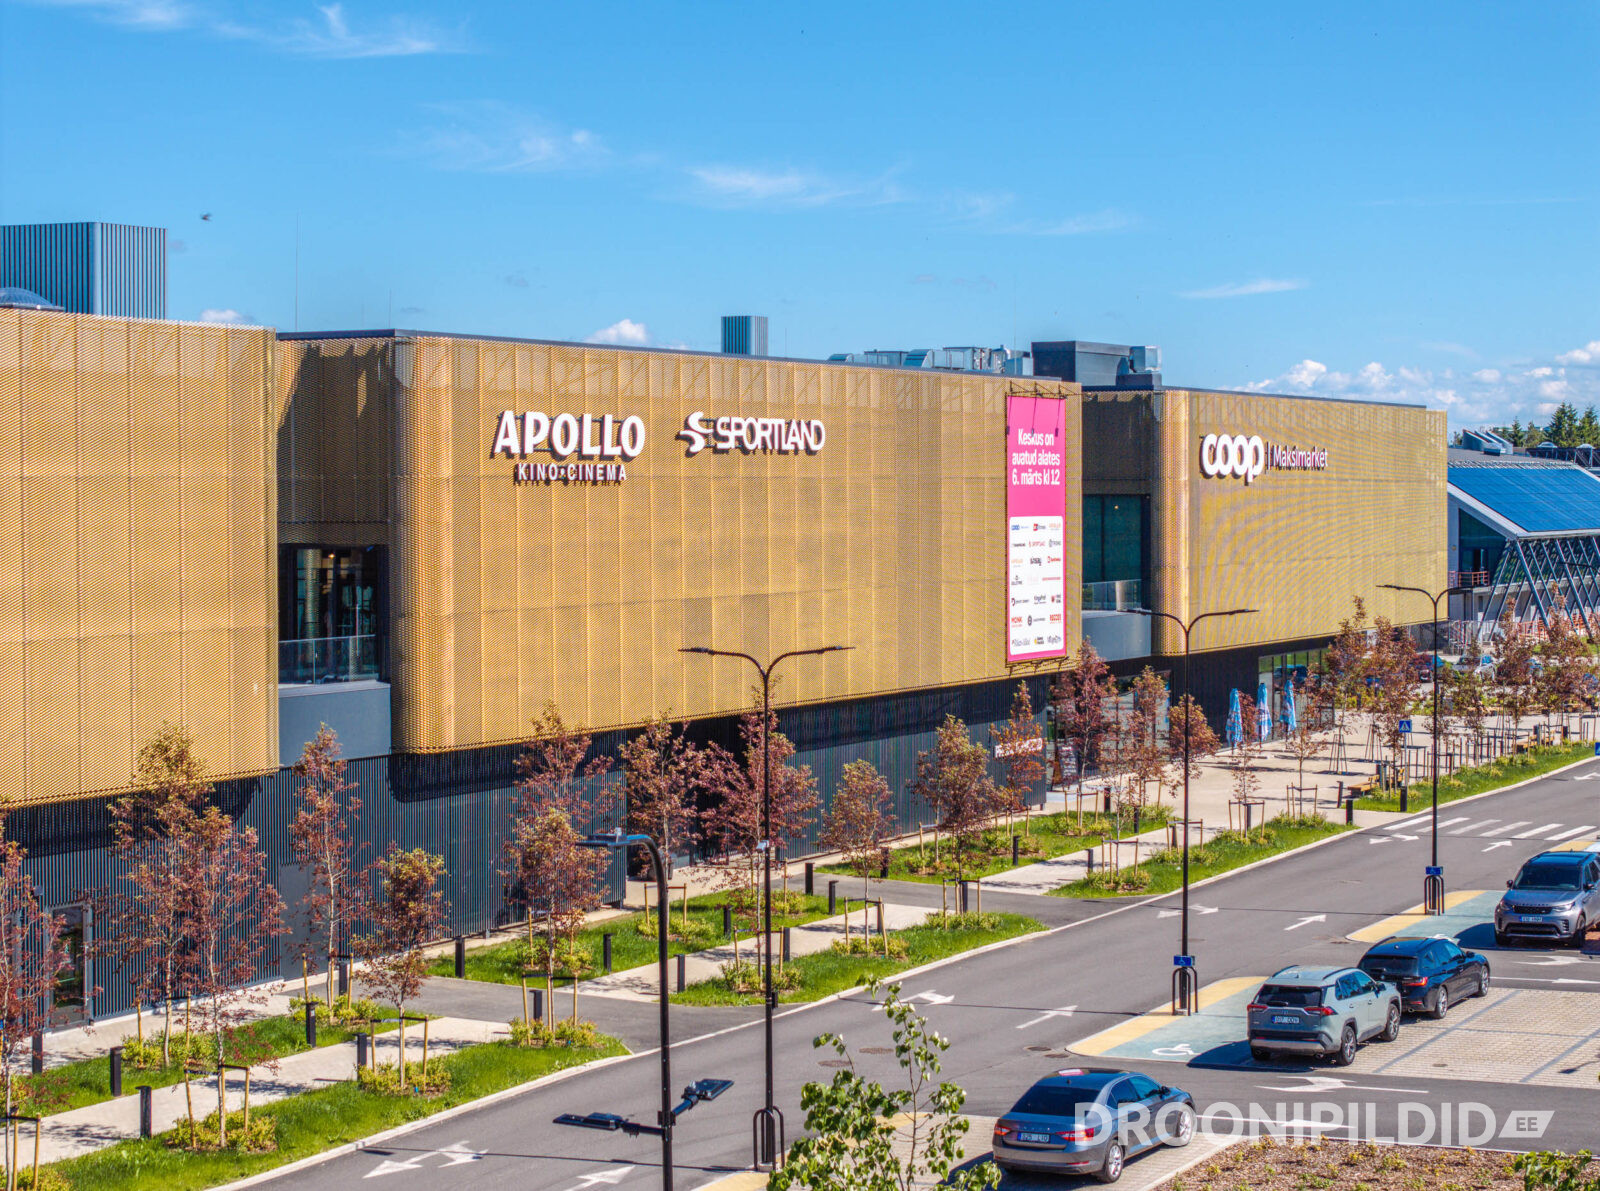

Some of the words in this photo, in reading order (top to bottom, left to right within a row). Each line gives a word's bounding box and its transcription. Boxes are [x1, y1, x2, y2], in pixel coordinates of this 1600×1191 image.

[494, 410, 646, 457] APOLLO
[716, 416, 826, 451] SPORTLAND
[1018, 428, 1044, 446] Keskus
[1044, 433, 1054, 446] on
[1012, 449, 1037, 466] avatud
[1038, 449, 1060, 466] alates
[1273, 445, 1328, 468] Maksimarket
[1012, 468, 1020, 485] 6.
[1020, 468, 1042, 485] märts
[1043, 468, 1050, 485] kl
[1051, 468, 1060, 485] 12
